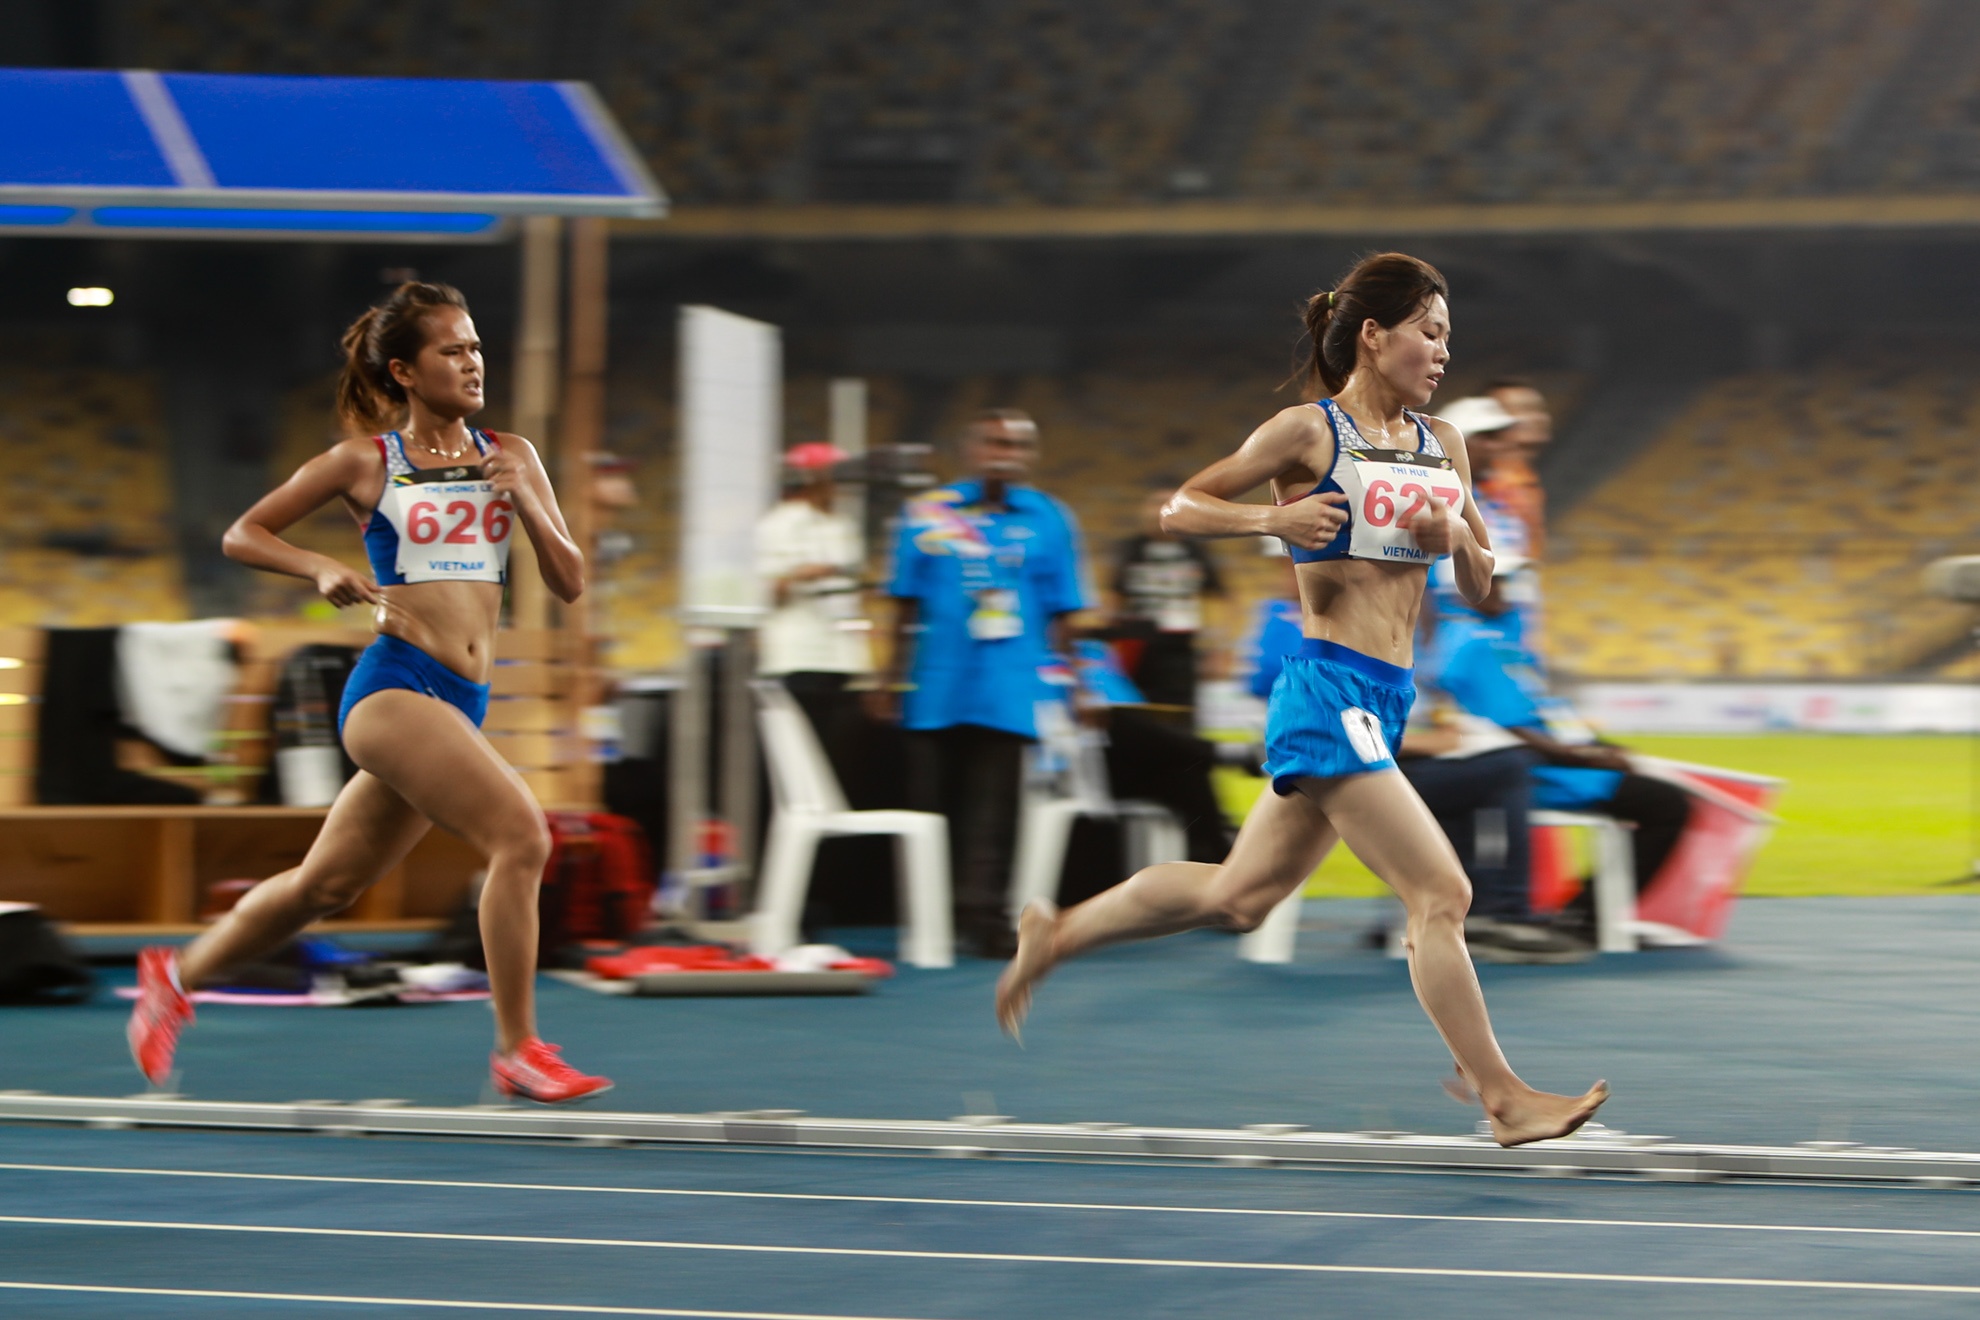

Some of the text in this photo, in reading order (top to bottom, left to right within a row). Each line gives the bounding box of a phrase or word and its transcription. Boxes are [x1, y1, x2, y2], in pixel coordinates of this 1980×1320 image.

[1391, 467, 1429, 477] THI HUE
[407, 500, 513, 544] 626
[429, 561, 485, 571] VIETNAM
